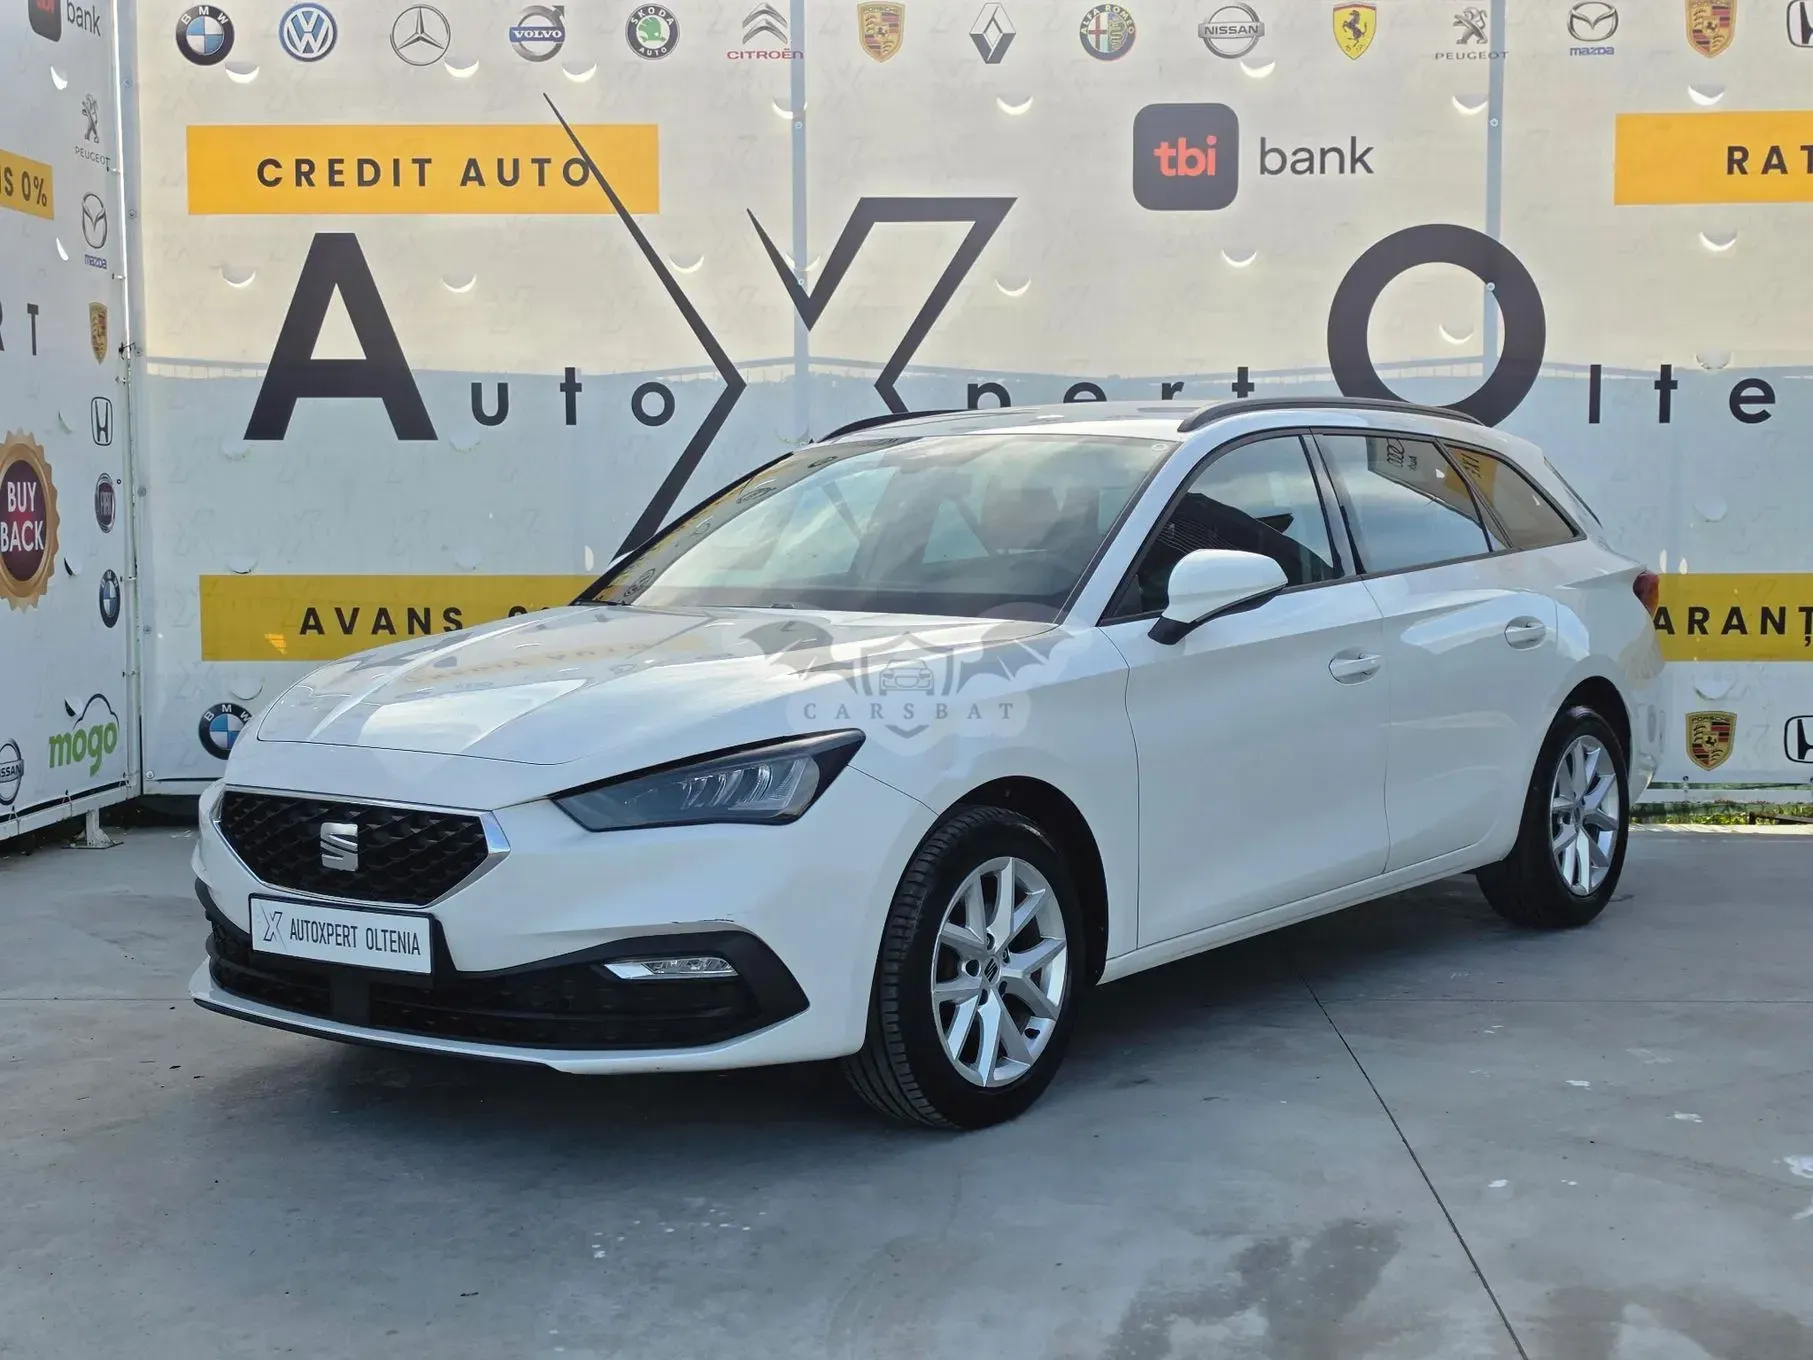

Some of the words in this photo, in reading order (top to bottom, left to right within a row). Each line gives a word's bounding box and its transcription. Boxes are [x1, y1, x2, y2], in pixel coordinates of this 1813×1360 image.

[66, 0, 101, 37] bank
[181, 7, 229, 25] BMW
[1080, 8, 1100, 35] ALFA
[1105, 5, 1134, 34] ROMEO
[1204, 25, 1260, 35] NISSAN
[513, 30, 562, 38] VOLVO
[639, 47, 668, 56] AUTO
[1435, 51, 1509, 60] PEUGEOT
[1154, 135, 1217, 177] tbi
[1259, 136, 1375, 176] bank
[1726, 145, 1813, 176] RAT
[257, 158, 432, 187] CREDIT
[460, 158, 591, 187] AUTO
[21, 170, 48, 207] 0%
[7, 481, 37, 513] BUY
[0, 520, 44, 553] BACK
[300, 606, 464, 635] AVANS
[204, 703, 252, 721] BMW
[49, 722, 117, 777] mogo
[290, 918, 358, 948] AUTOXPERT
[366, 927, 421, 956] OLTENIA
